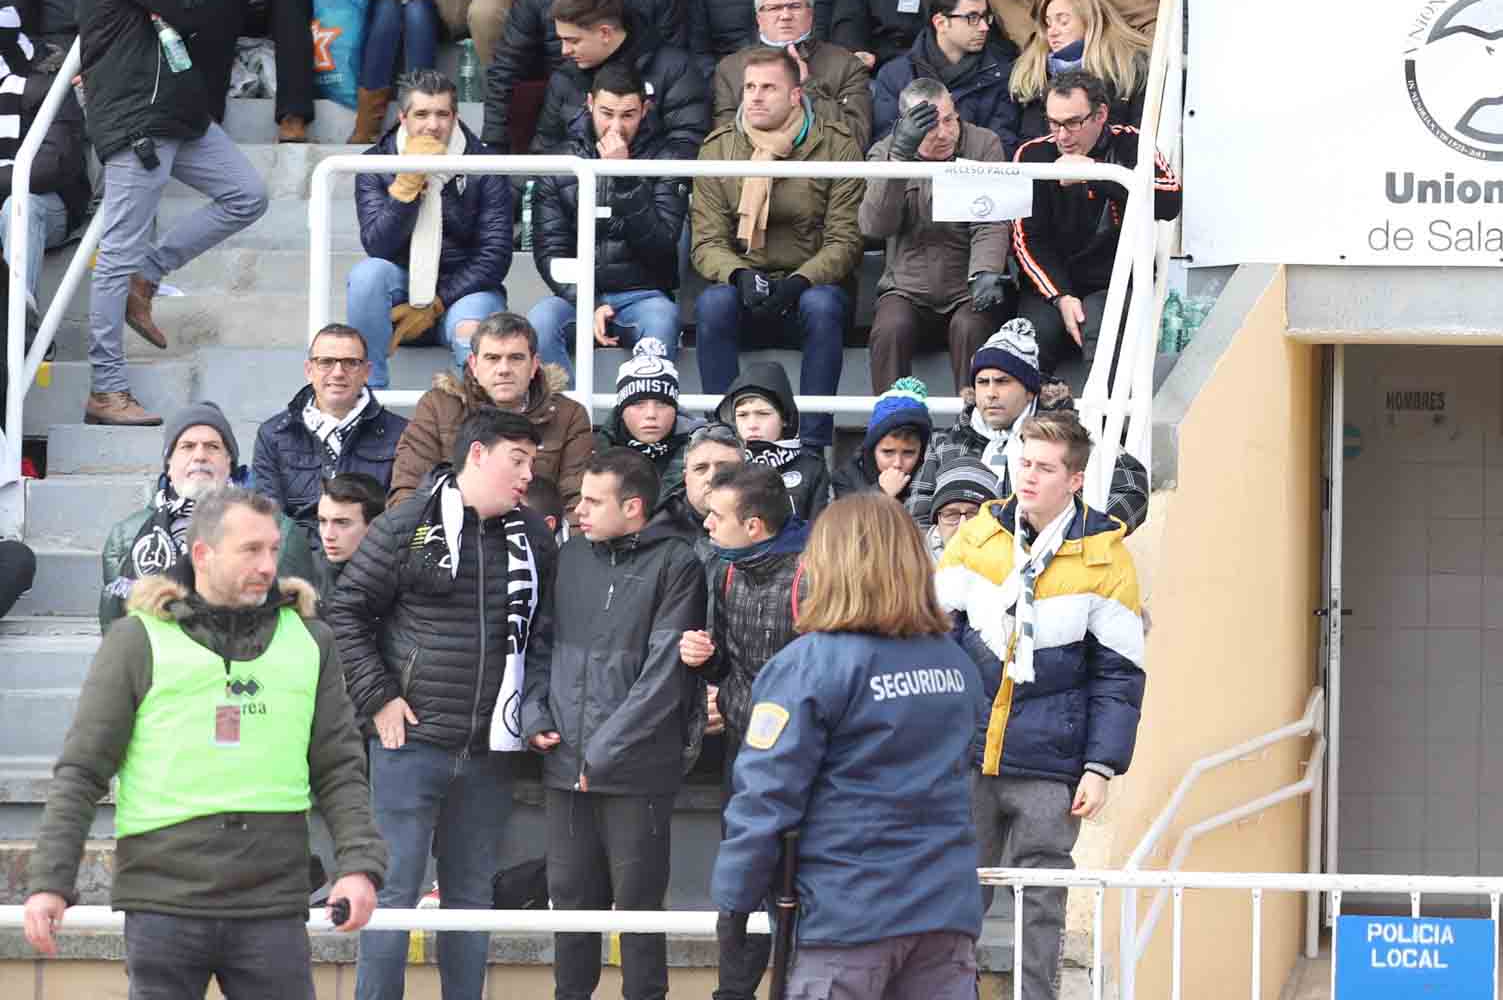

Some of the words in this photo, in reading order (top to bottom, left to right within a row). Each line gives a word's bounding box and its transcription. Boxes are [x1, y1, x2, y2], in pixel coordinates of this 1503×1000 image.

[1368, 219, 1414, 251] de
[1387, 391, 1446, 410] HOMBRES
[870, 668, 965, 701] SEGURIDAD
[1367, 922, 1454, 944] POLICIA
[1371, 947, 1448, 968] LOCAL
